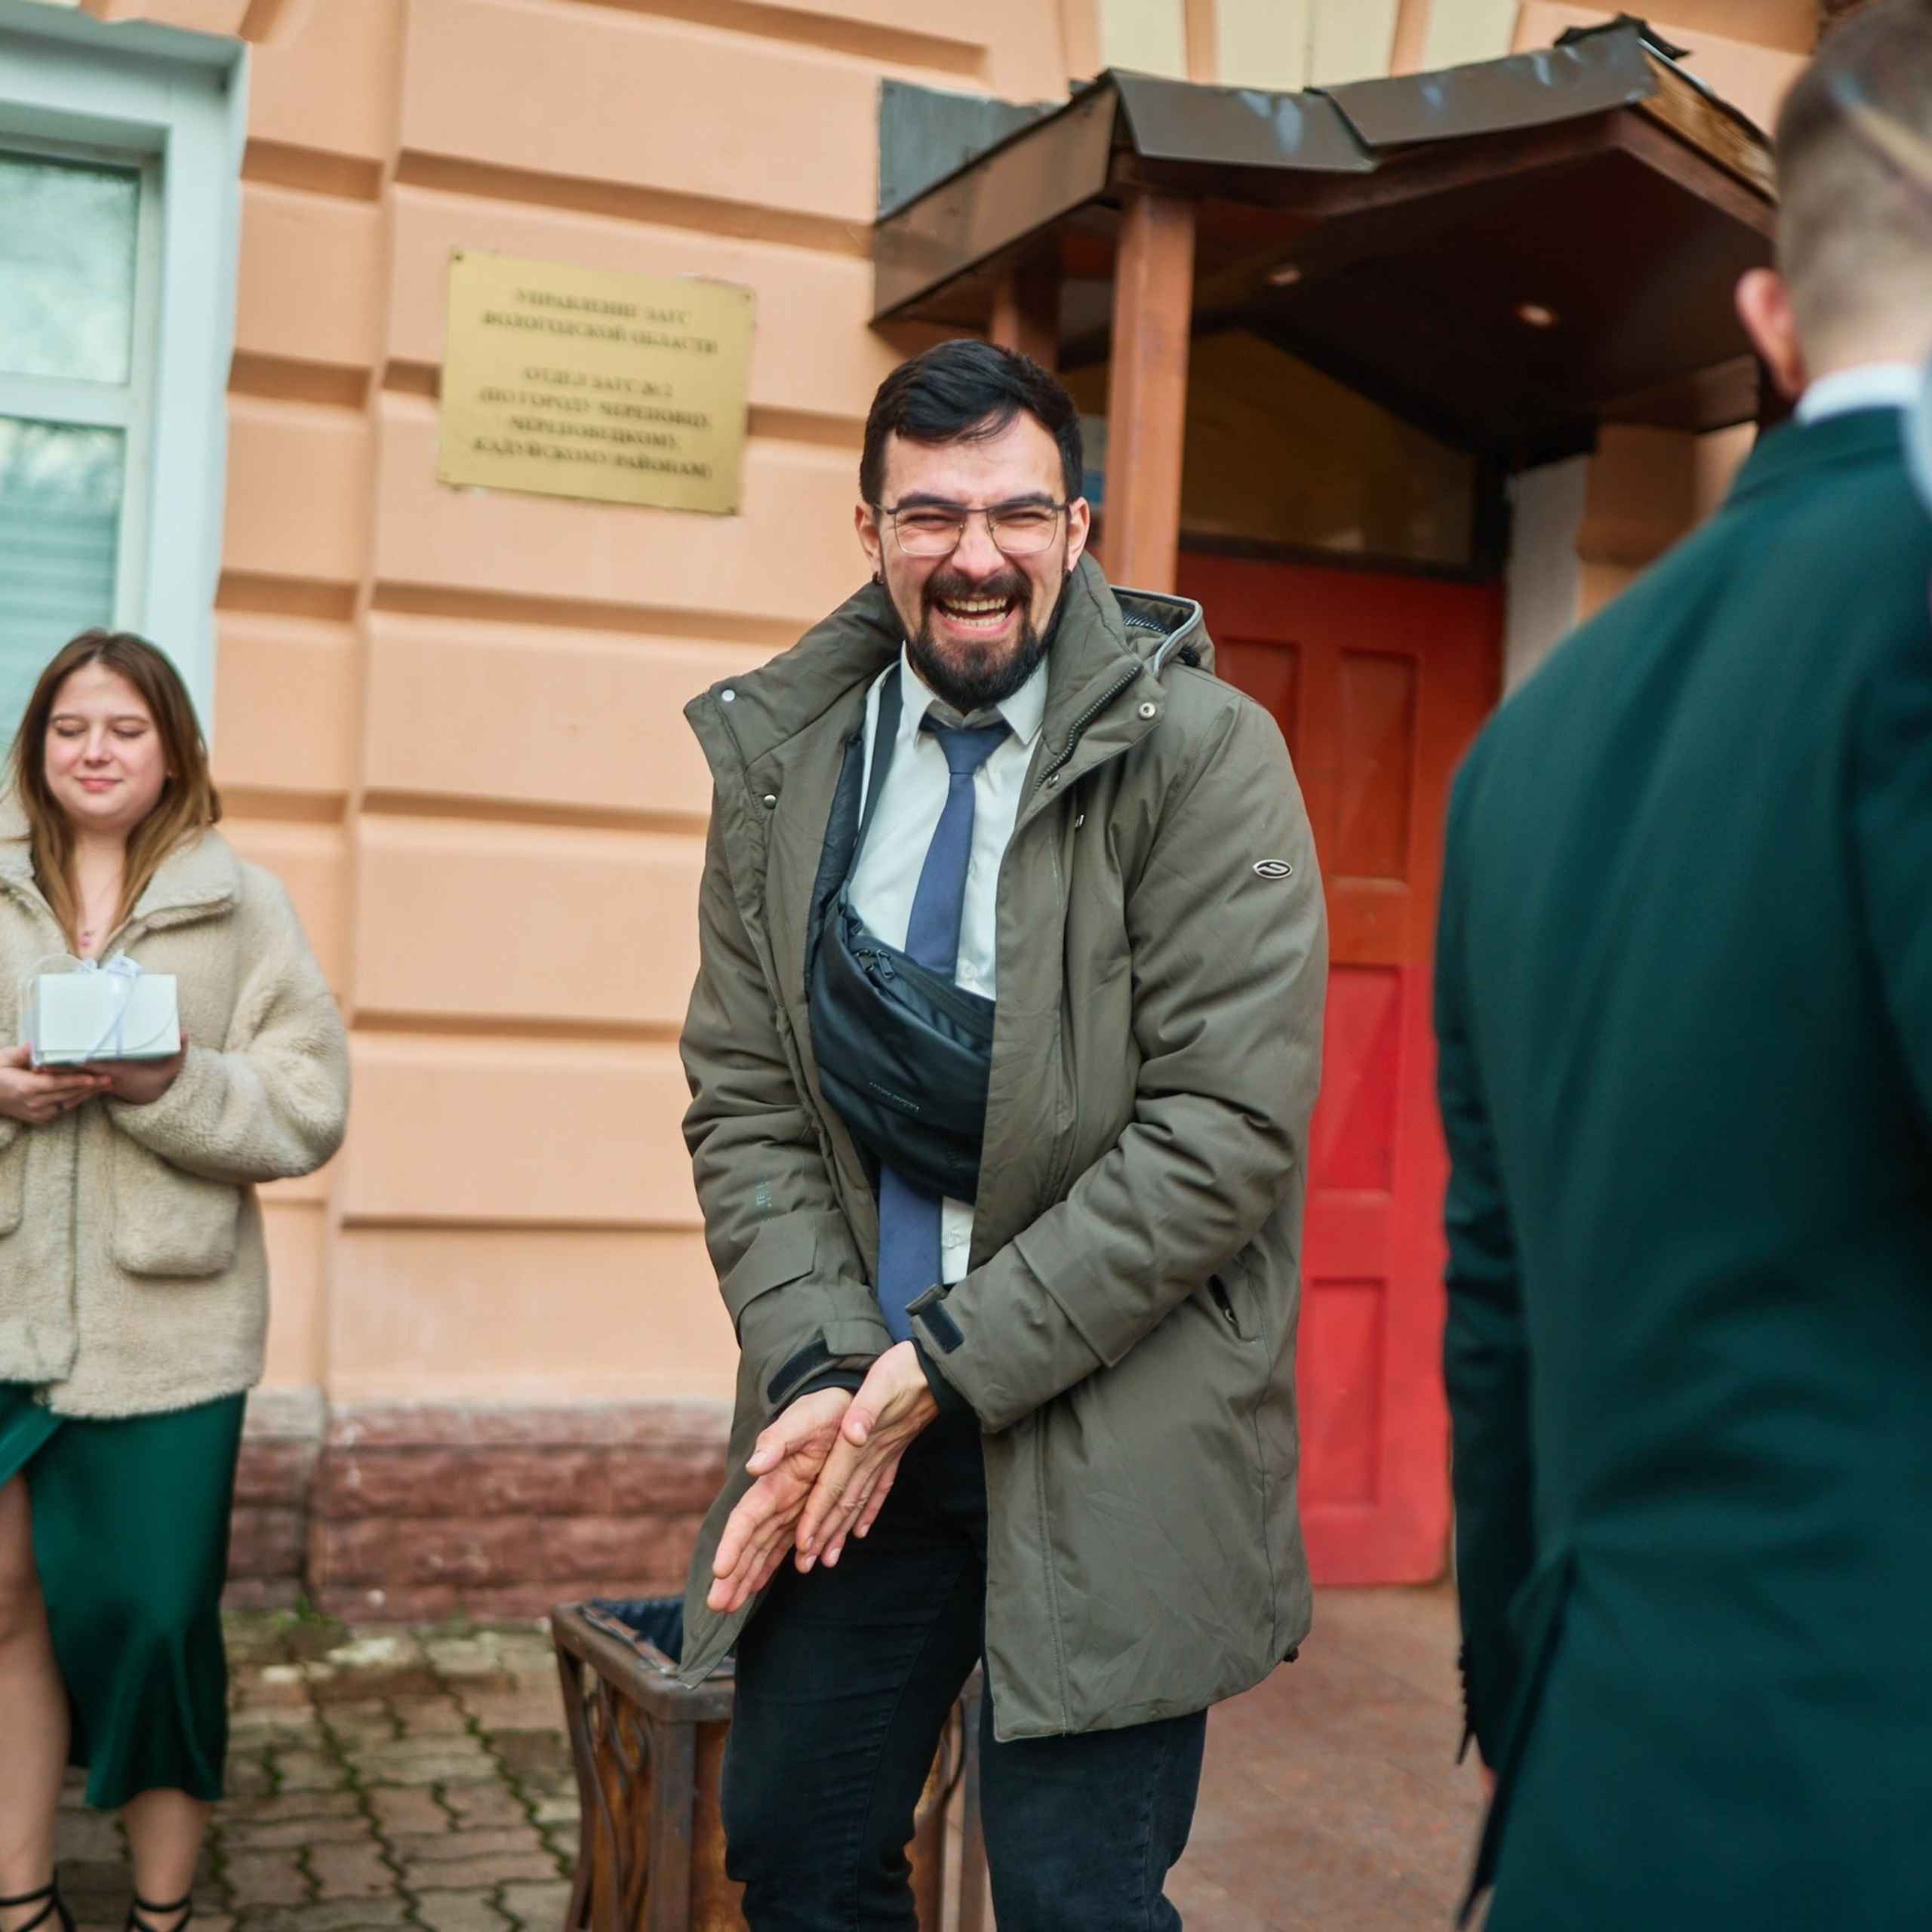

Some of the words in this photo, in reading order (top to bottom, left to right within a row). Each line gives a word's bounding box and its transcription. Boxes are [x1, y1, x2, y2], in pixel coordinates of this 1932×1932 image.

[515, 288, 638, 318] УПРАВЛЕНИЕ
[644, 306, 693, 325] ЗАГС
[481, 310, 627, 342] ВОЛОГОДСКОЙ
[631, 328, 719, 355] ОБЛАСТИ
[524, 366, 587, 387] ОТДЕЛ
[518, 391, 593, 414] ГОРОДУ
